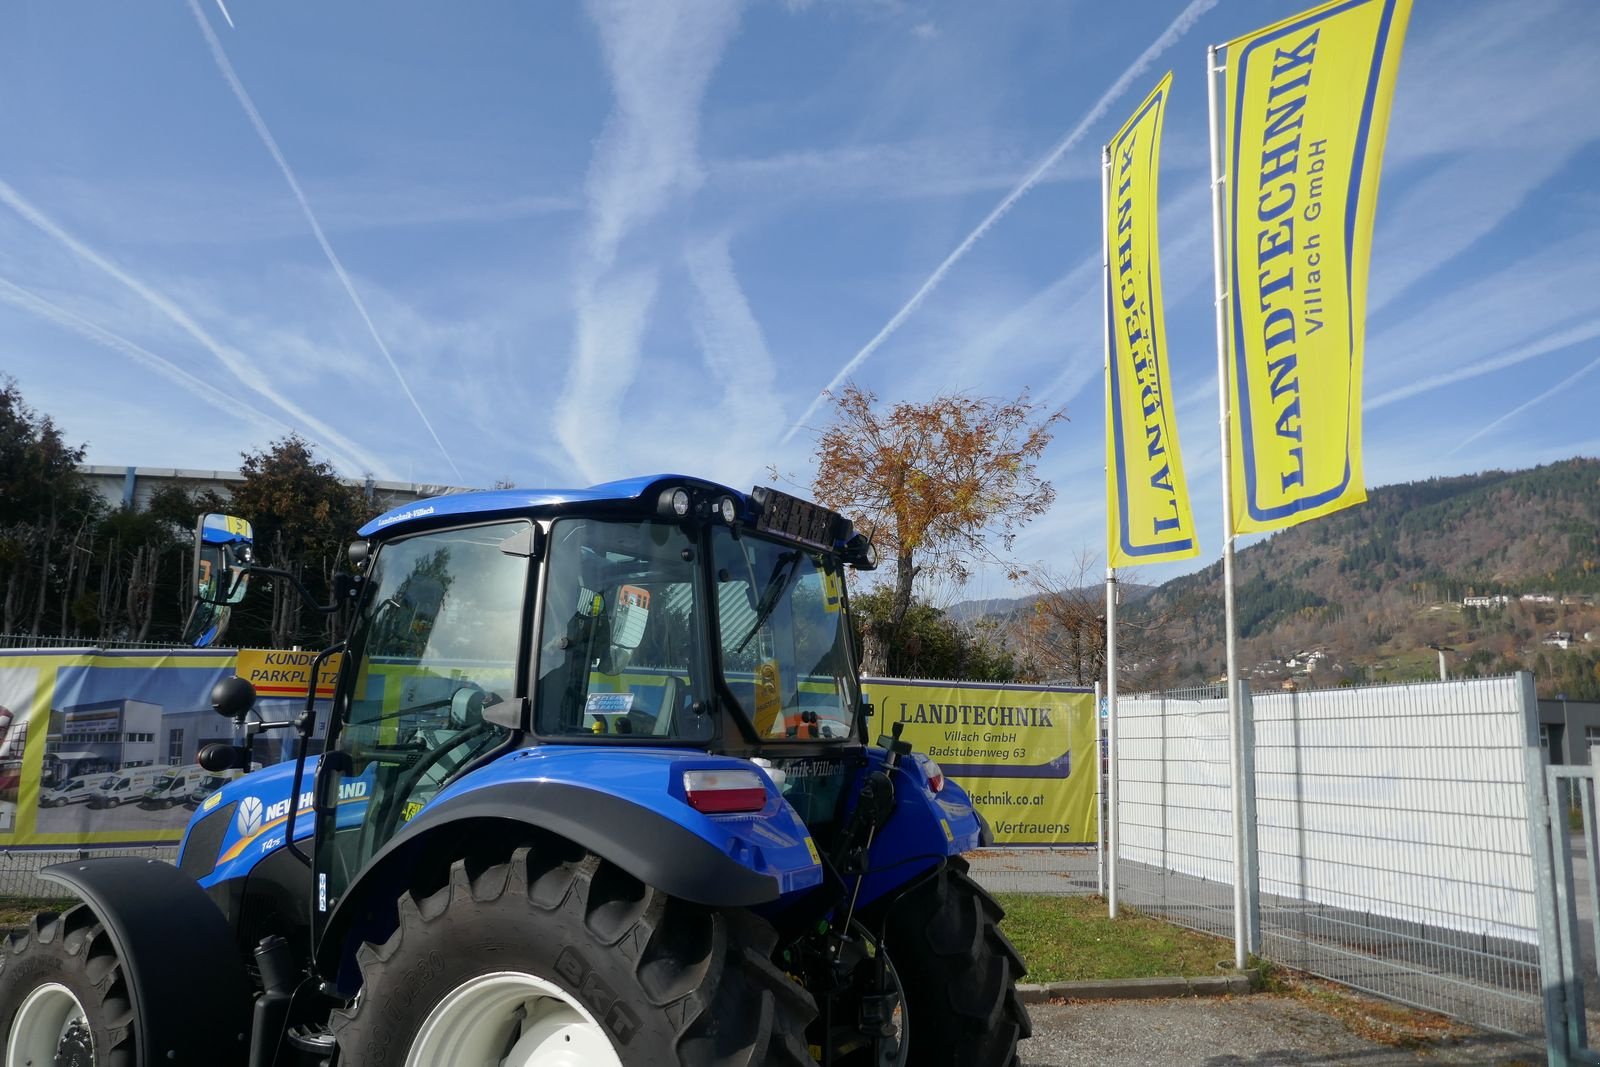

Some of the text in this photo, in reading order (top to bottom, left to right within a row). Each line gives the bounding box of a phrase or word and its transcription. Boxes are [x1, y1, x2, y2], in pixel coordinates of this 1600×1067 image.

[1303, 138, 1327, 336] Villach GmbH
[1257, 28, 1320, 494] LANDTECHNIK
[1117, 130, 1181, 536] LANDTECHNIK
[250, 669, 338, 684] PARKPLTZ
[900, 703, 1053, 727] LANDTECHNIK
[944, 731, 1017, 743] Villach GmbH
[928, 746, 1026, 759] Badstubenweg 63
[784, 760, 845, 777] hnik-Villach
[968, 790, 1045, 806] technik.co.at
[995, 821, 1070, 834] Vertrauens
[553, 945, 643, 1046] BKT
